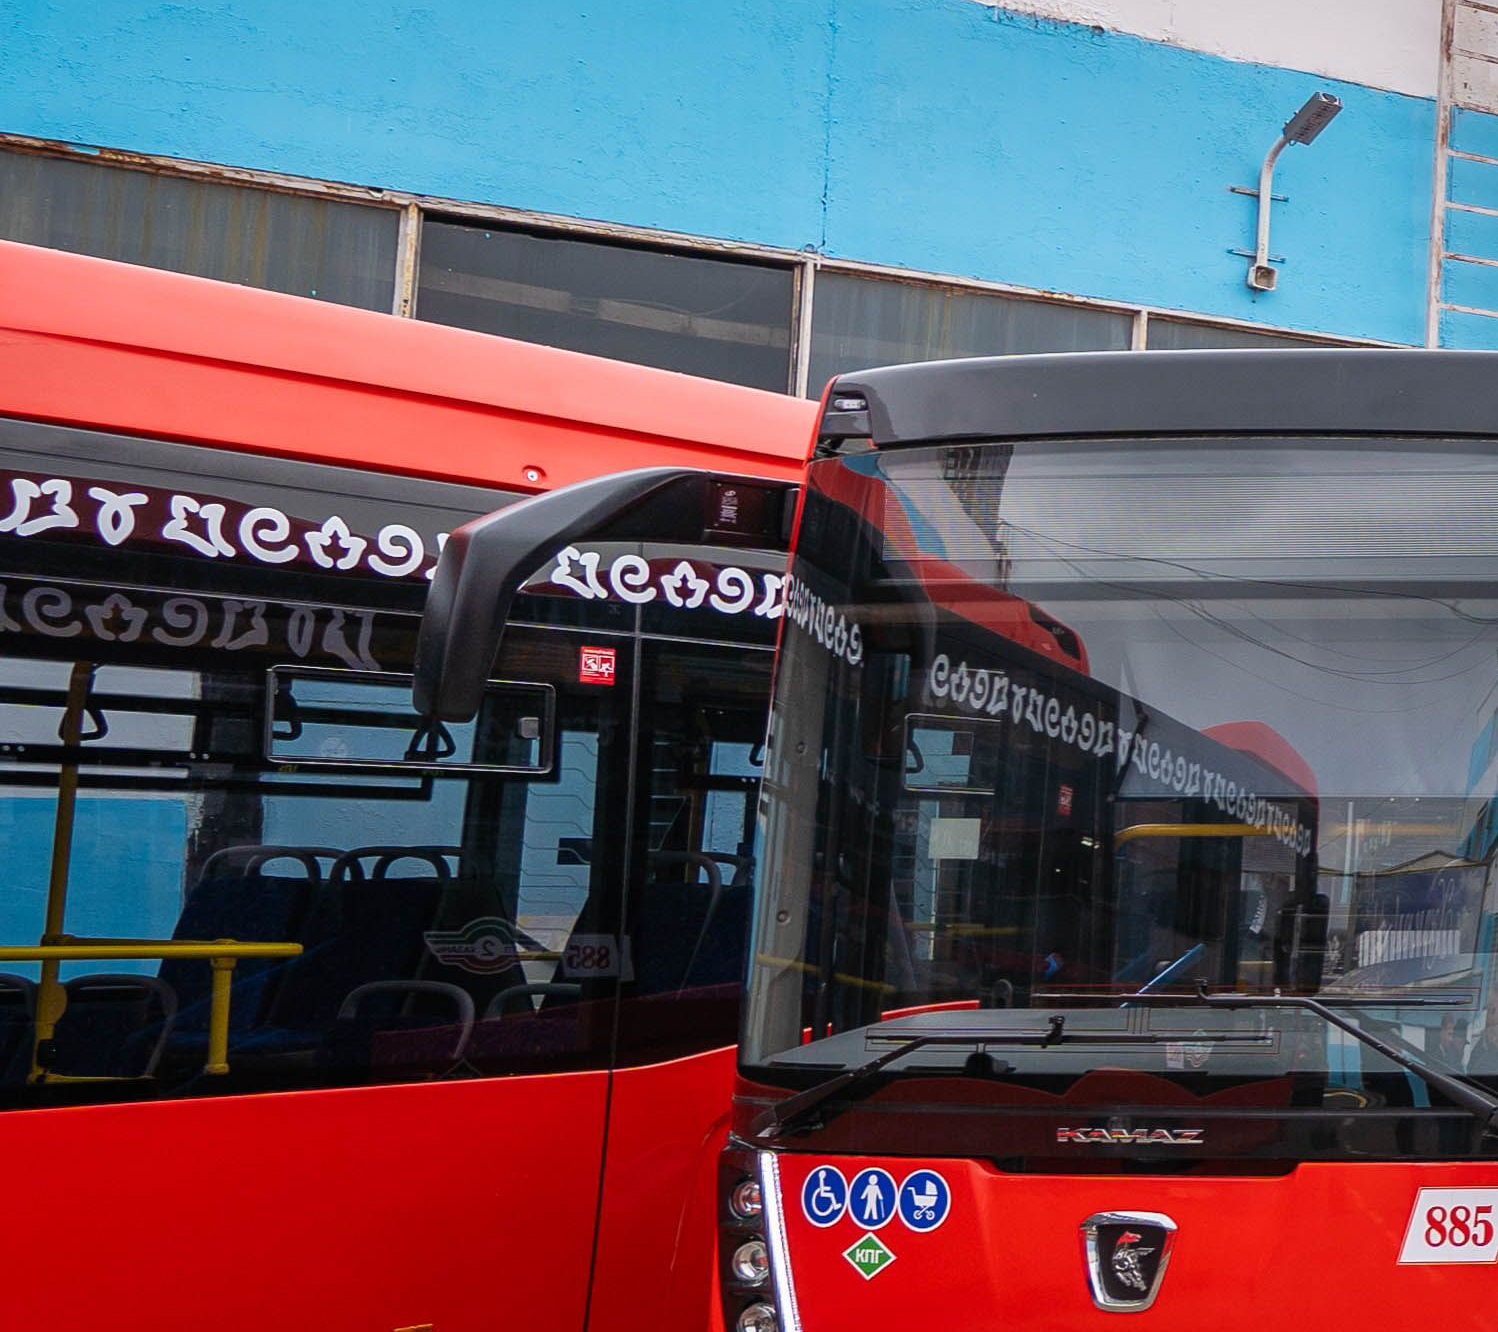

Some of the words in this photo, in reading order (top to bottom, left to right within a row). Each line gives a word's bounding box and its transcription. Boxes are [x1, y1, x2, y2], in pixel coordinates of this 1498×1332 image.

[1056, 1127, 1205, 1144] KAMAZ
[1423, 1204, 1495, 1248] 885
[855, 1248, 884, 1264] КПГ
